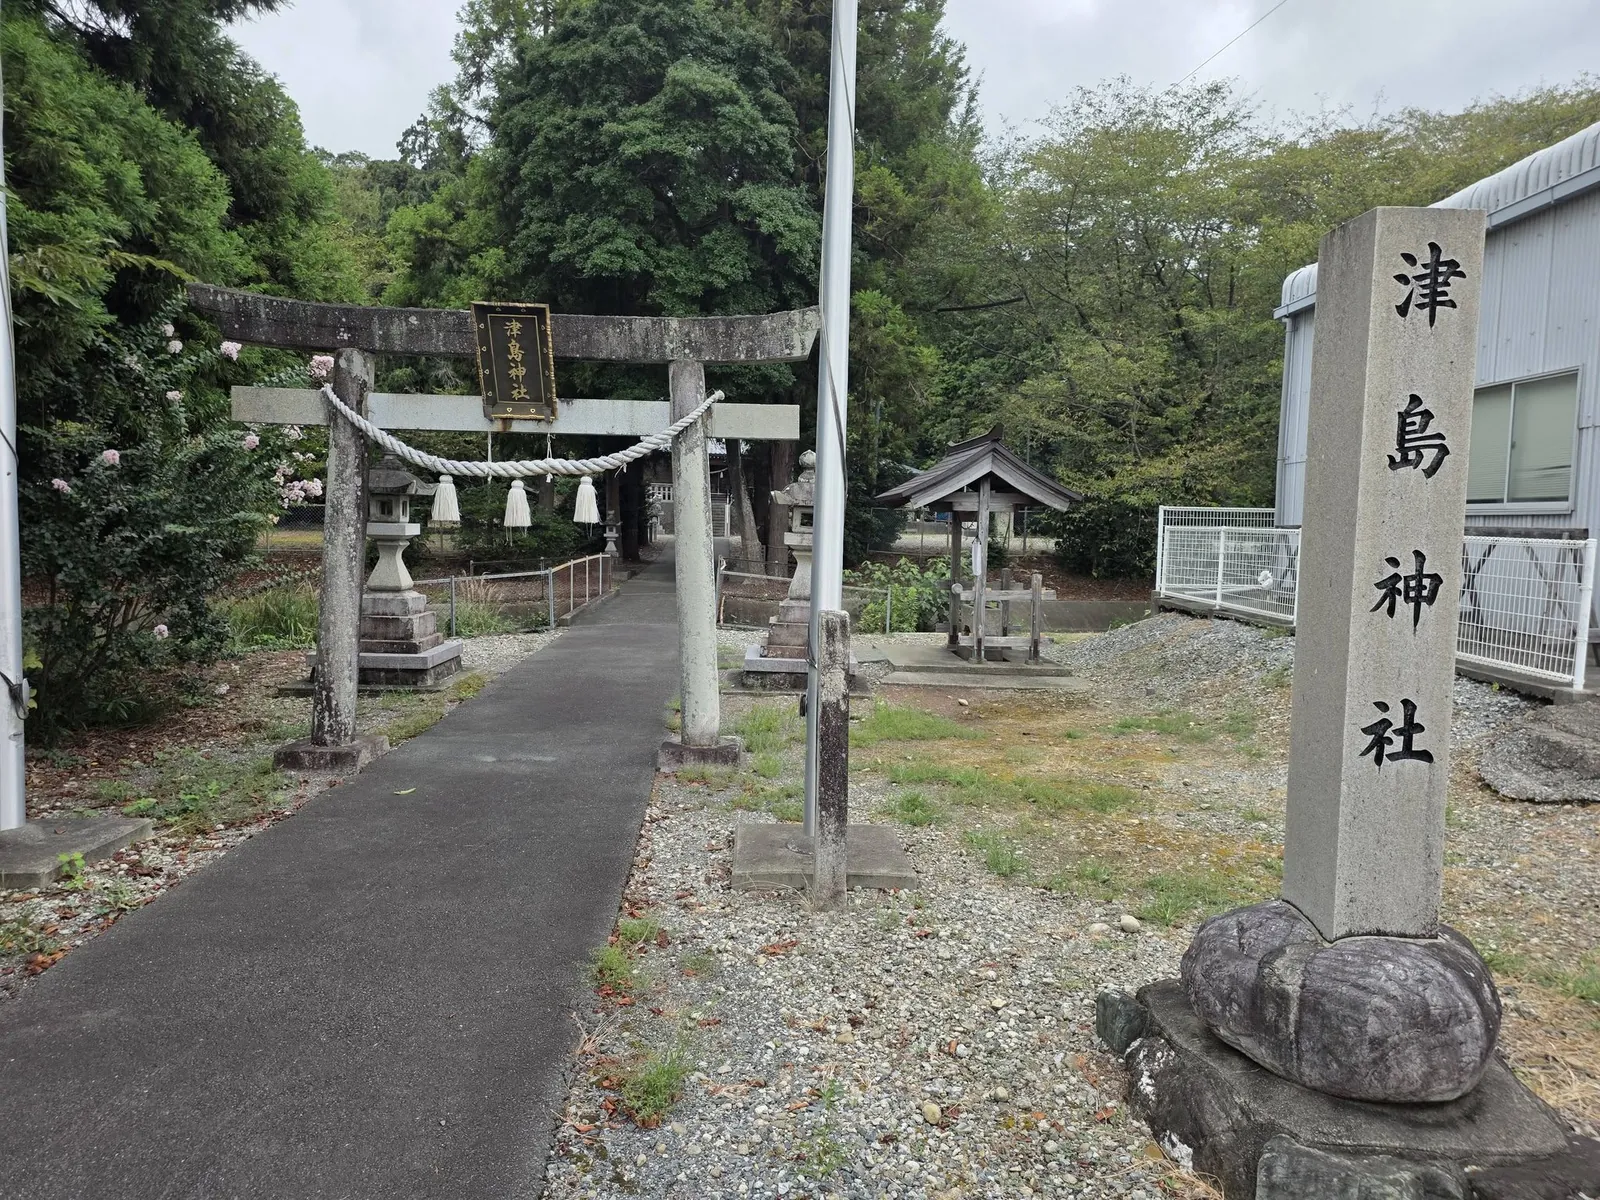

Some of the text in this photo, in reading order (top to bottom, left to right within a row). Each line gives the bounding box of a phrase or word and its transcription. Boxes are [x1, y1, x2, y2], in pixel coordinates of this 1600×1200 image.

[503, 318, 531, 401] 津島神社
[1360, 242, 1467, 767] 津島神社
